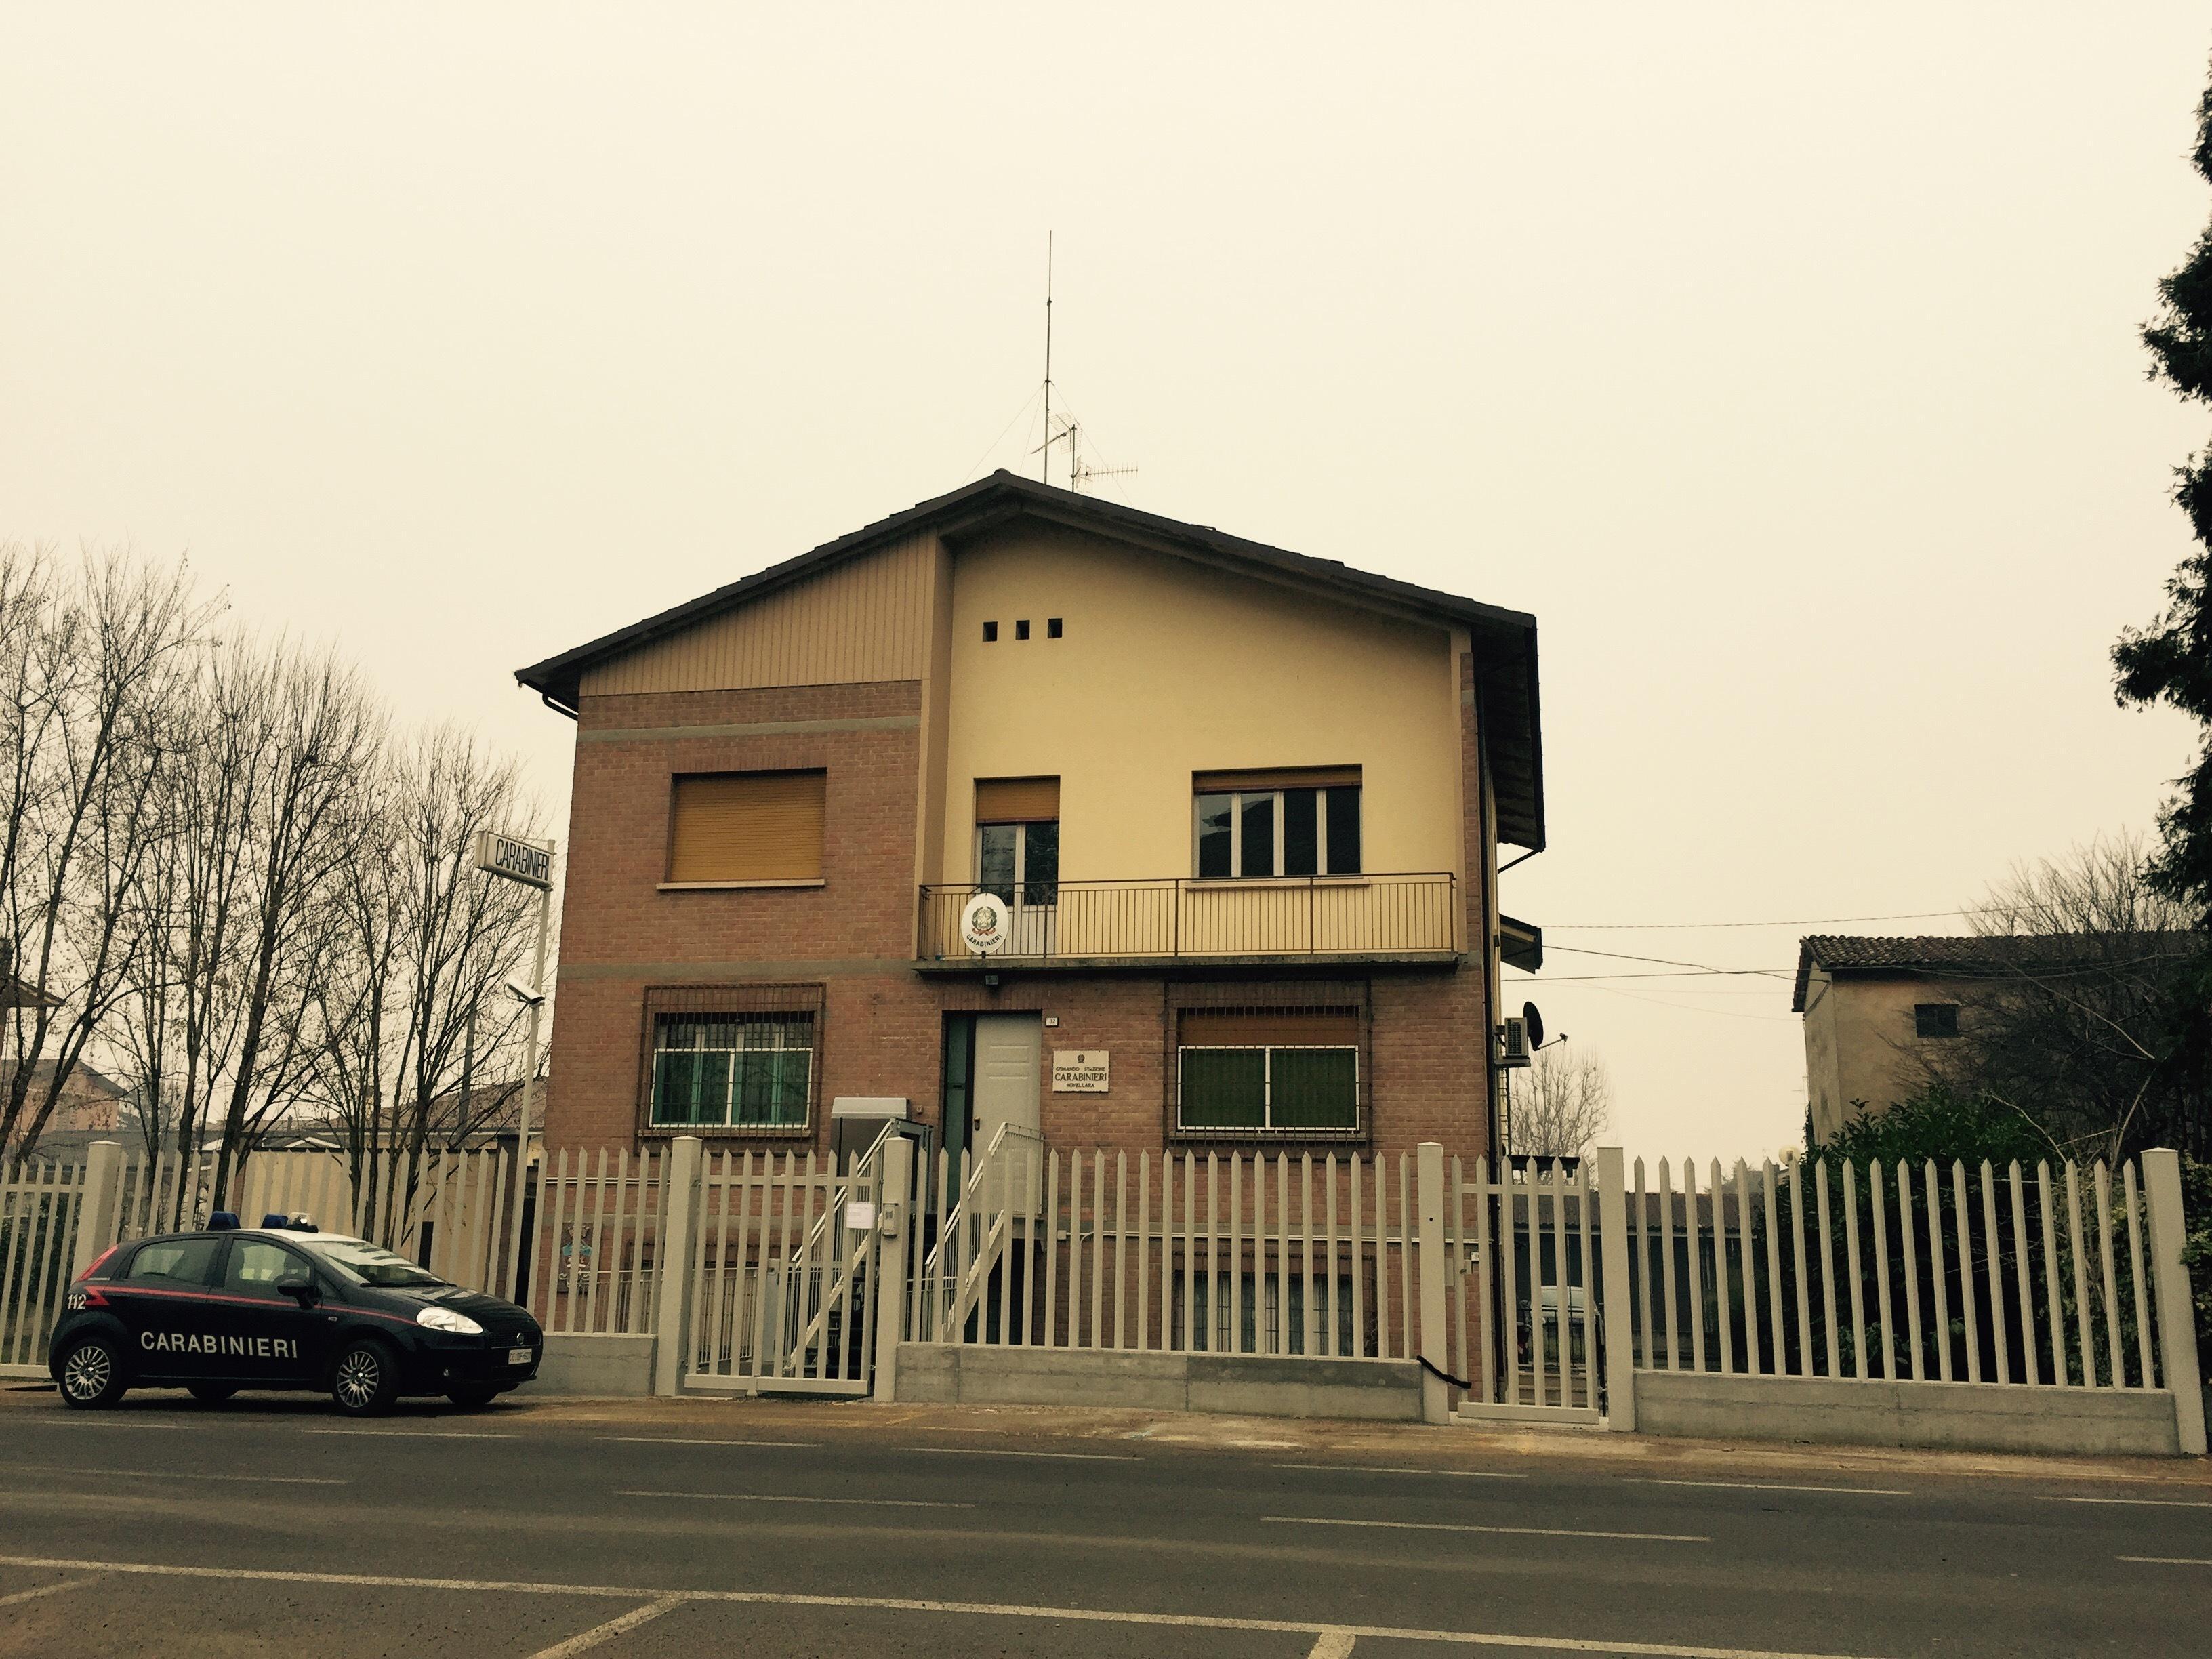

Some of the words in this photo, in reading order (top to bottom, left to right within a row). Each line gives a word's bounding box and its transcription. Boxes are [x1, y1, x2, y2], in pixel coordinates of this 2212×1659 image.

[495, 838, 550, 881] CARABINIERI
[966, 933, 1002, 947] CARABINIERI
[1054, 1073, 1107, 1082] CARABINIERI
[67, 1294, 87, 1309] 112
[140, 1330, 298, 1359] CARABINIERI
